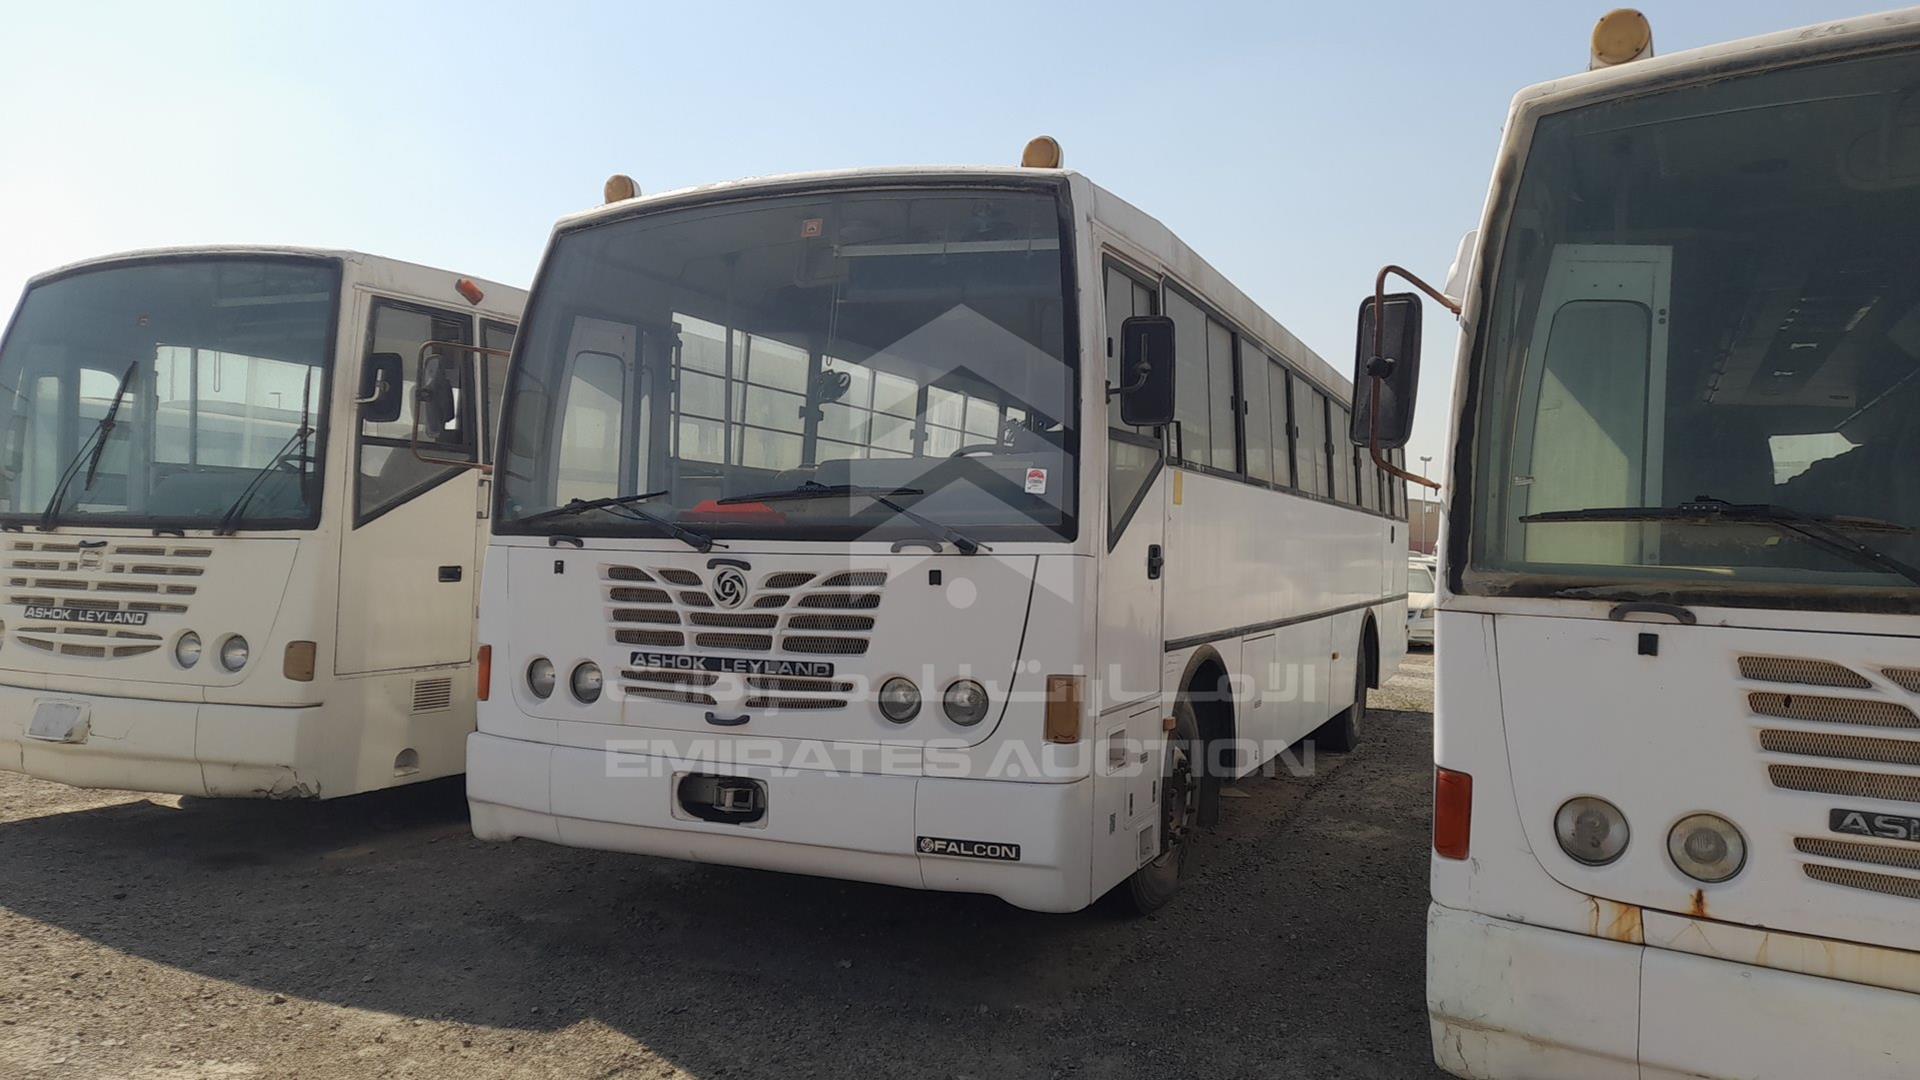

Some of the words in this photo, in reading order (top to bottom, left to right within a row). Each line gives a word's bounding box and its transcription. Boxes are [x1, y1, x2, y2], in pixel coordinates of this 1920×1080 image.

[25, 606, 71, 620] ASHOK
[78, 610, 145, 625] LEYLAND
[632, 653, 706, 671] ASHOK
[721, 659, 831, 677] LEYLAND
[934, 840, 1016, 858] FALCON
